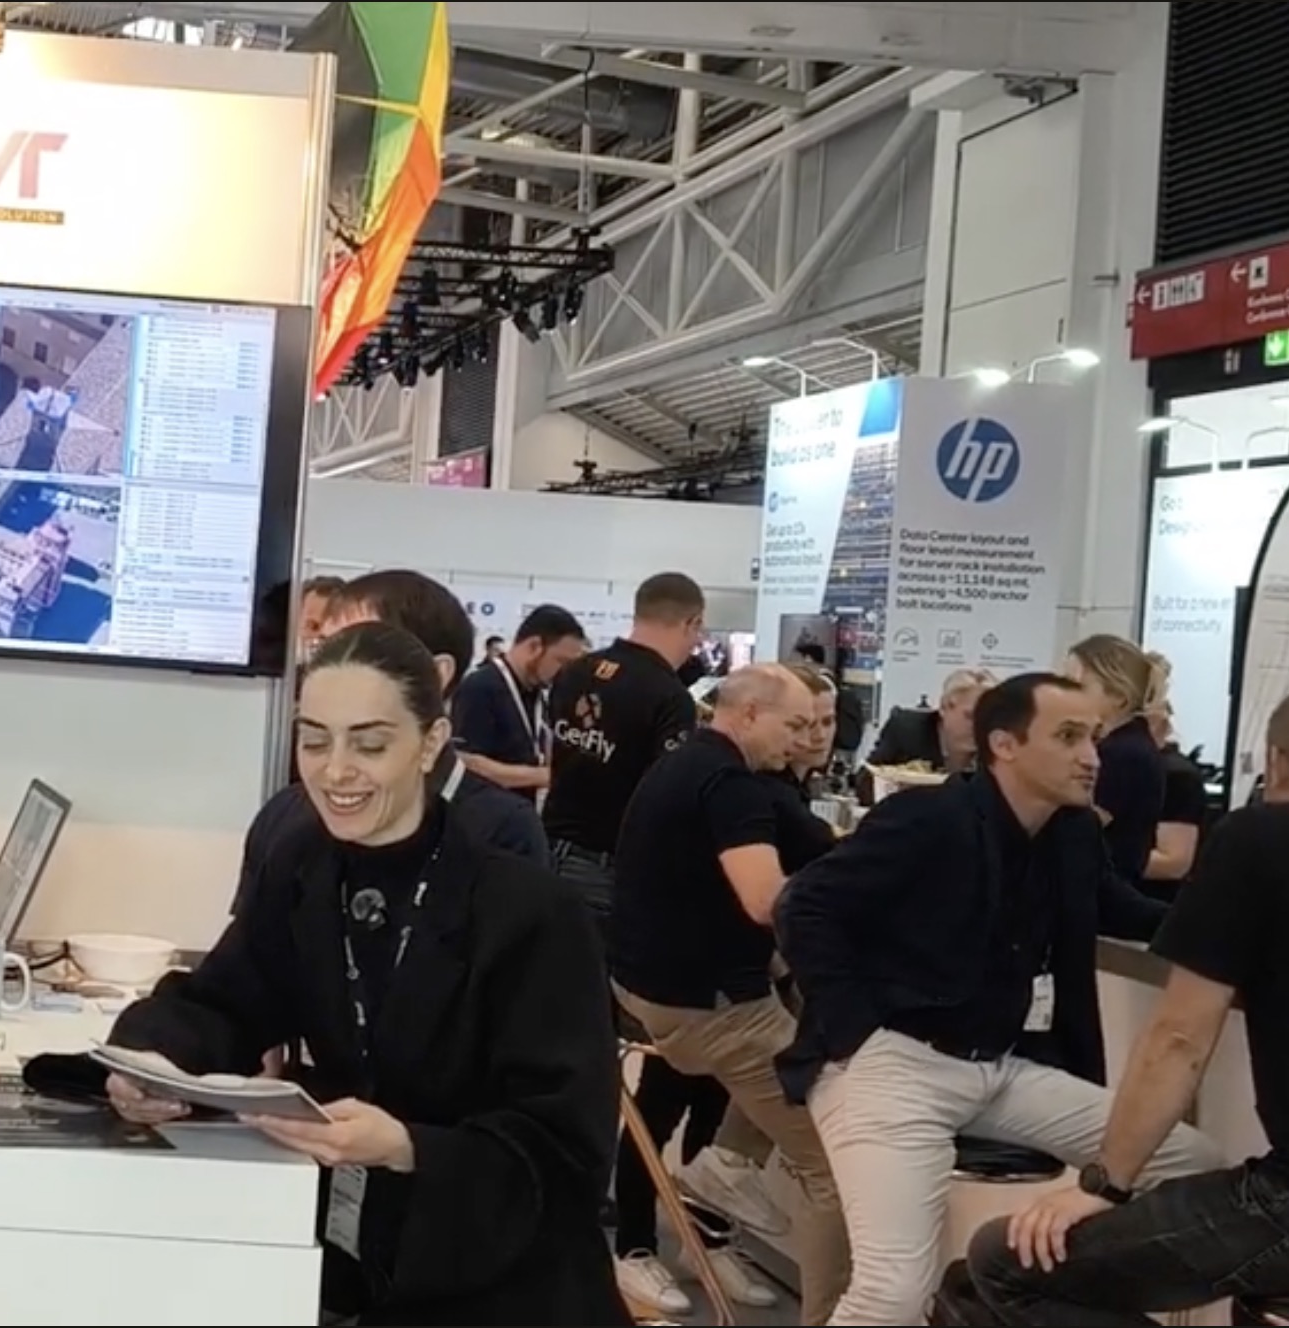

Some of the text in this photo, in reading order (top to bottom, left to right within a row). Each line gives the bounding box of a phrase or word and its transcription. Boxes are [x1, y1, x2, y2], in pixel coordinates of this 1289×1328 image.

[944, 417, 1014, 501] hp
[899, 528, 1030, 546] Data Center layout and
[899, 541, 1034, 560] floor level measurement
[898, 556, 1046, 574] for server rack installation
[897, 571, 936, 582] across
[897, 585, 947, 599] covering
[989, 590, 1030, 601] anchor
[895, 598, 973, 612] bolt locations
